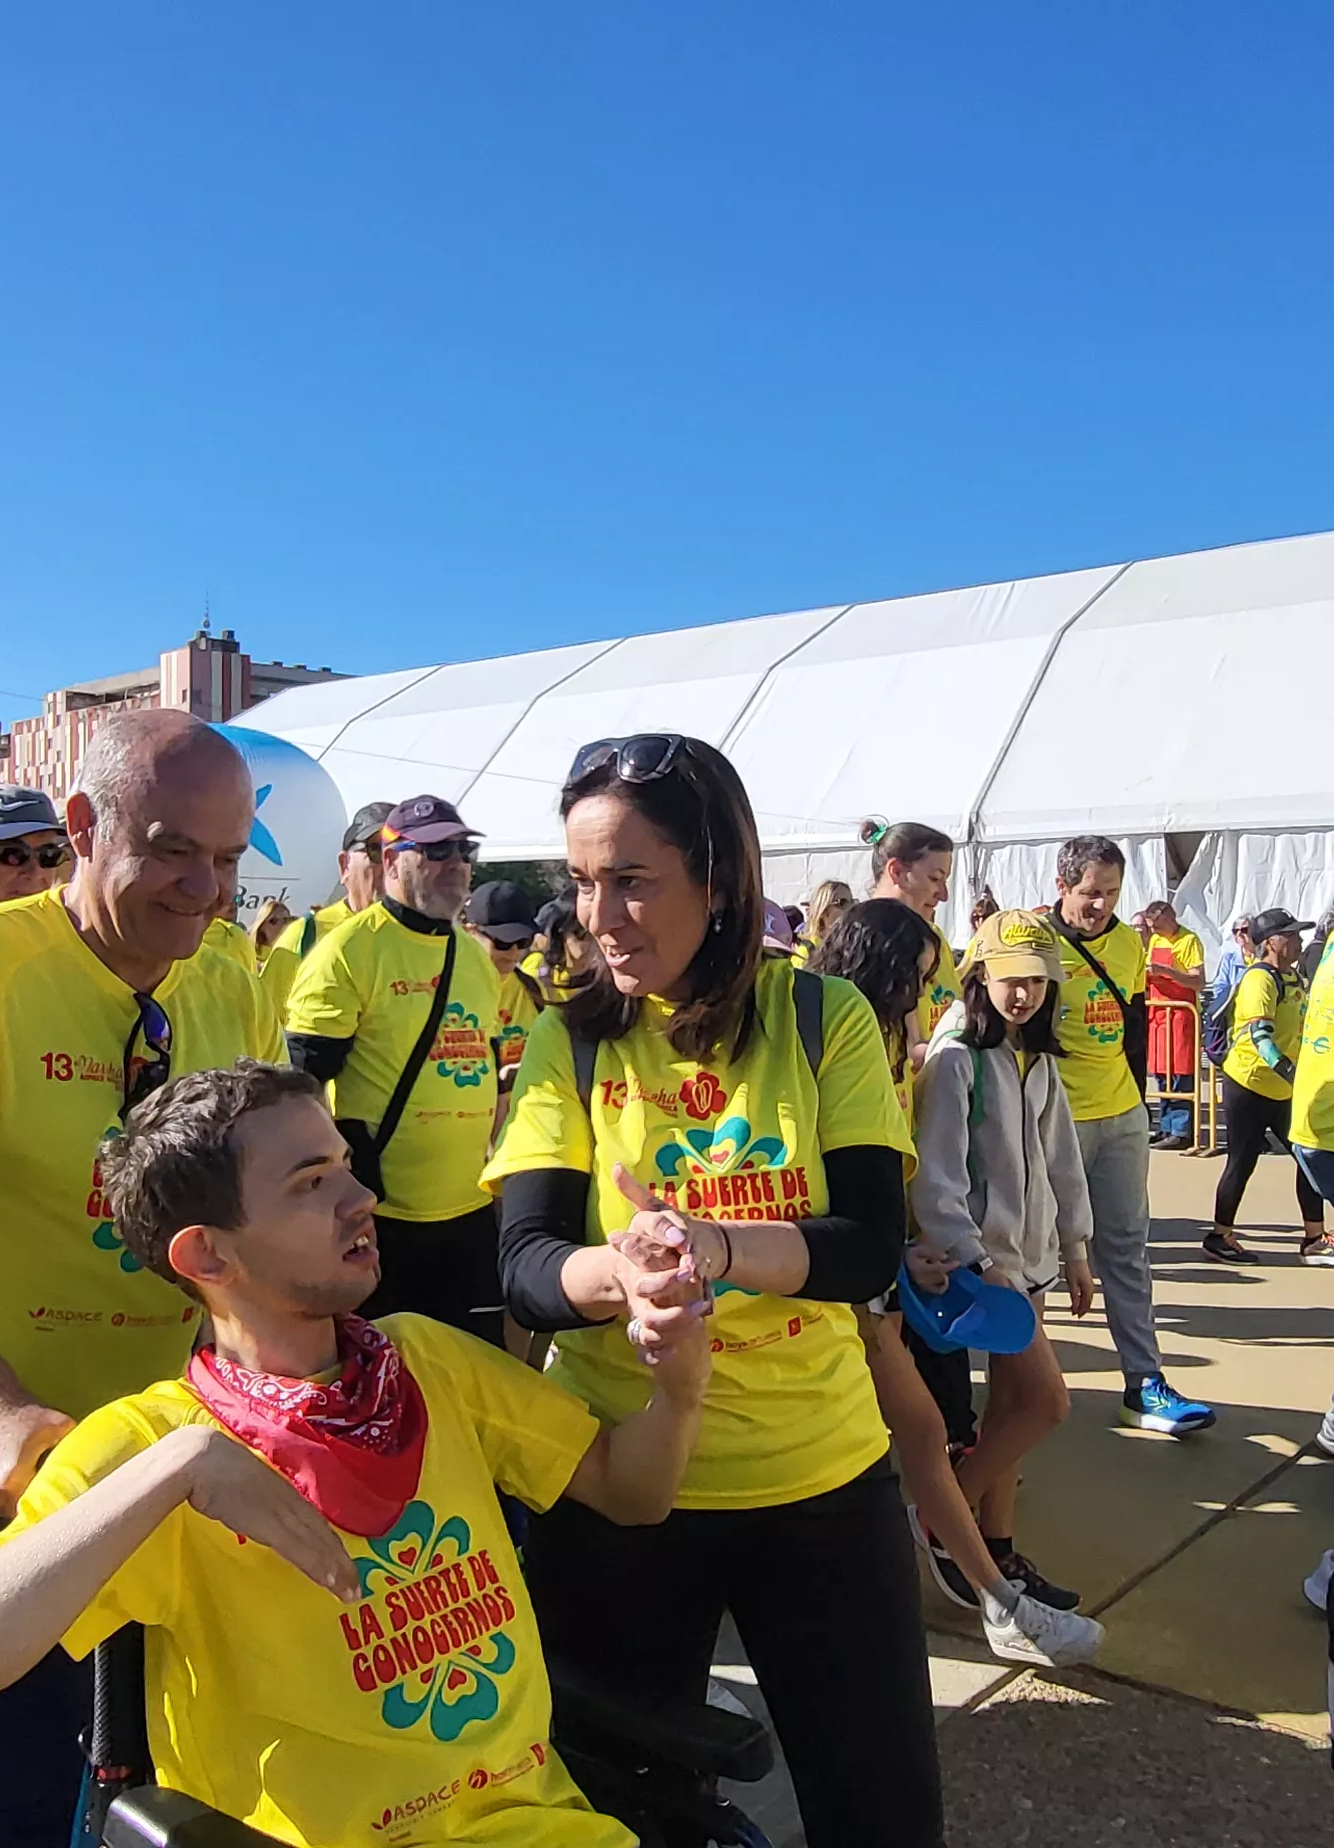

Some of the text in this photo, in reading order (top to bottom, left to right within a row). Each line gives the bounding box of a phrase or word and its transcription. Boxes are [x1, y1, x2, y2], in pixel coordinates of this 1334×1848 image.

[390, 980, 409, 996] 13
[40, 1052, 75, 1082] 13
[686, 1169, 776, 1210] SUERTE
[780, 1166, 810, 1200] DE
[339, 1549, 500, 1651] LA SUERTE DE
[394, 1779, 461, 1821] ASPACE
